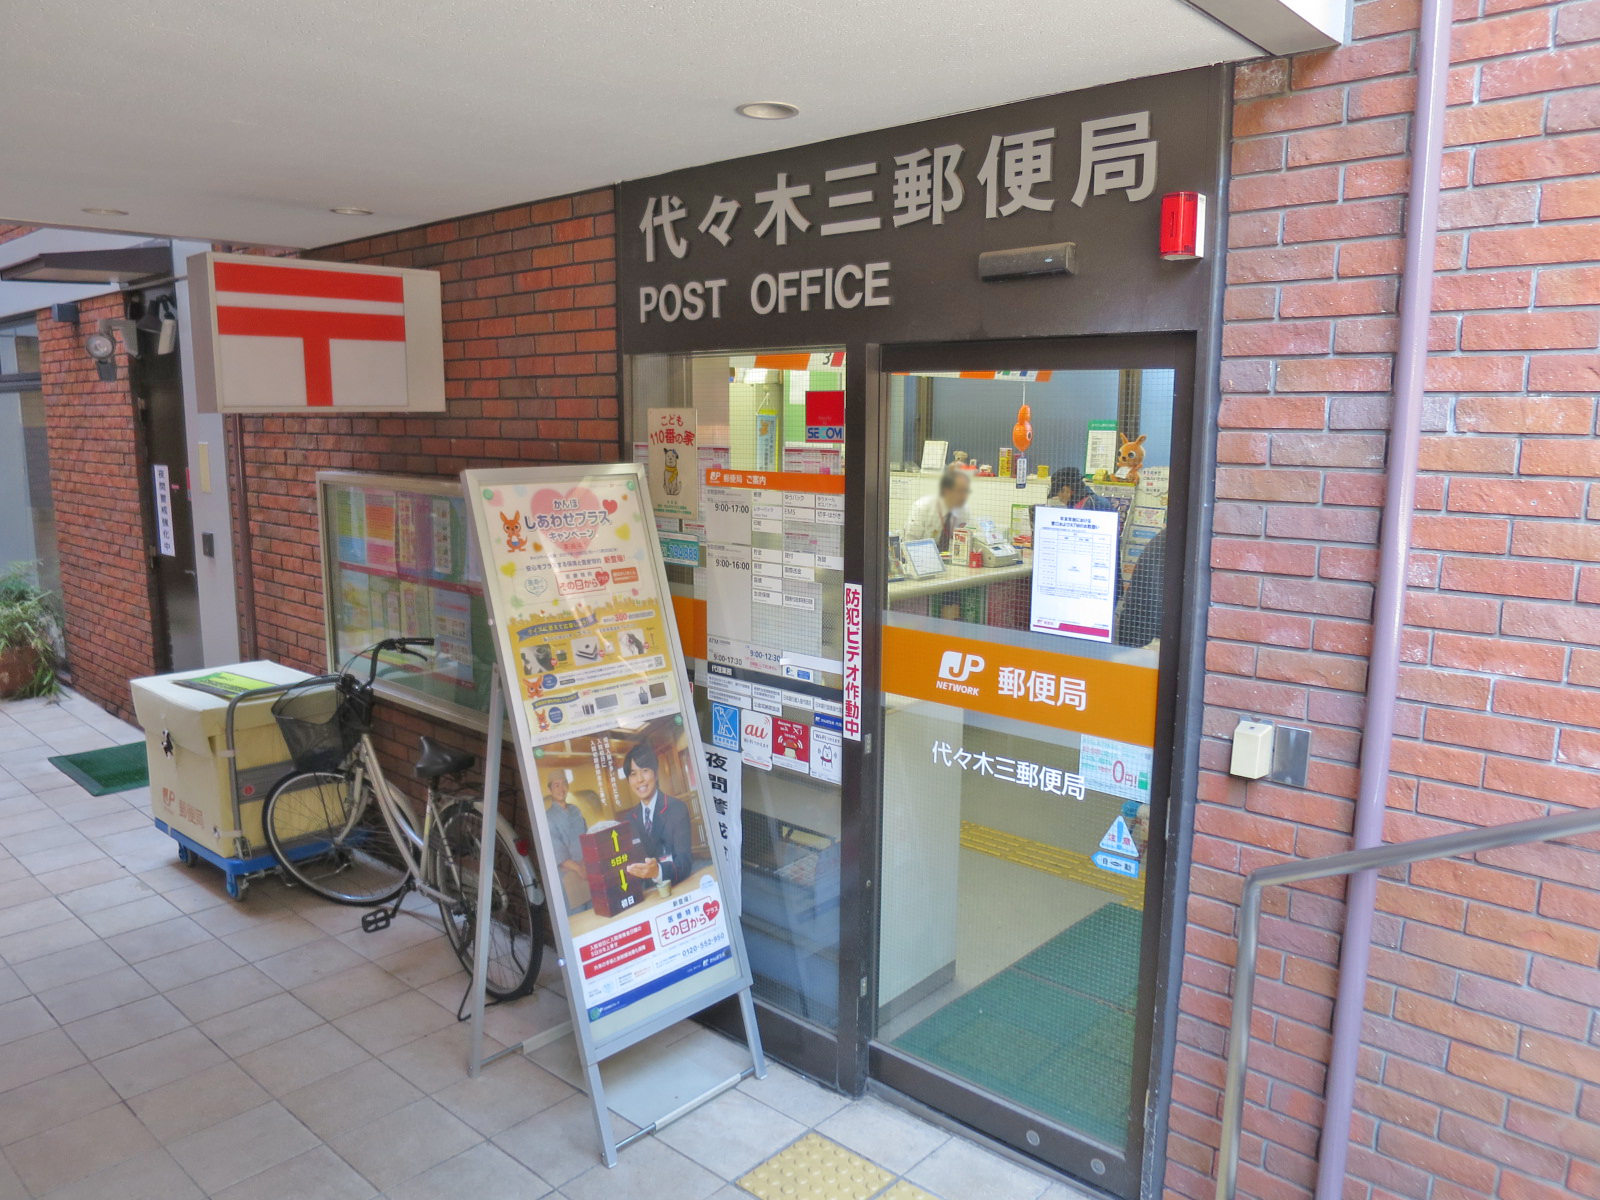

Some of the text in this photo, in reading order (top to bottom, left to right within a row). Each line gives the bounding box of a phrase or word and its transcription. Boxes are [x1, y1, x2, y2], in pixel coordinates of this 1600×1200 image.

[639, 111, 1159, 263] 代々木三郵便局
[639, 261, 892, 324] POST OFFICE
[661, 414, 684, 427] こども
[650, 428, 695, 447] 110番の家
[807, 427, 842, 440] SECOM
[723, 474, 742, 484] 郵便局
[746, 475, 767, 486] ご案内
[553, 499, 579, 510] かんぽ
[785, 494, 804, 502] ゆうパック
[158, 469, 171, 551] 夜間警戒強化中
[714, 503, 750, 514] 9:00-17:00
[524, 510, 611, 530] しあわせプラス
[548, 529, 595, 541] キャンペーン
[715, 559, 750, 570] 9:00-16:00
[560, 579, 599, 592] その日から
[708, 637, 719, 645] ATM
[713, 653, 743, 666] 9:00-17:30
[749, 649, 781, 663] 9:00-12:30
[845, 586, 861, 738] 防犯ビデオ作動中
[711, 664, 733, 676] 代理業務
[938, 650, 985, 682] JP
[935, 680, 980, 697] NETWORK
[997, 666, 1087, 712] 郵便局
[745, 724, 769, 739] au
[932, 740, 1086, 800] 代々木三郵便局
[178, 799, 205, 829] 郵便局
[610, 853, 628, 867] 5日分
[621, 895, 635, 909] 初日
[667, 905, 700, 924] 医療特約
[661, 905, 720, 940] その日から プラス
[682, 932, 725, 957] 0120-552-950
